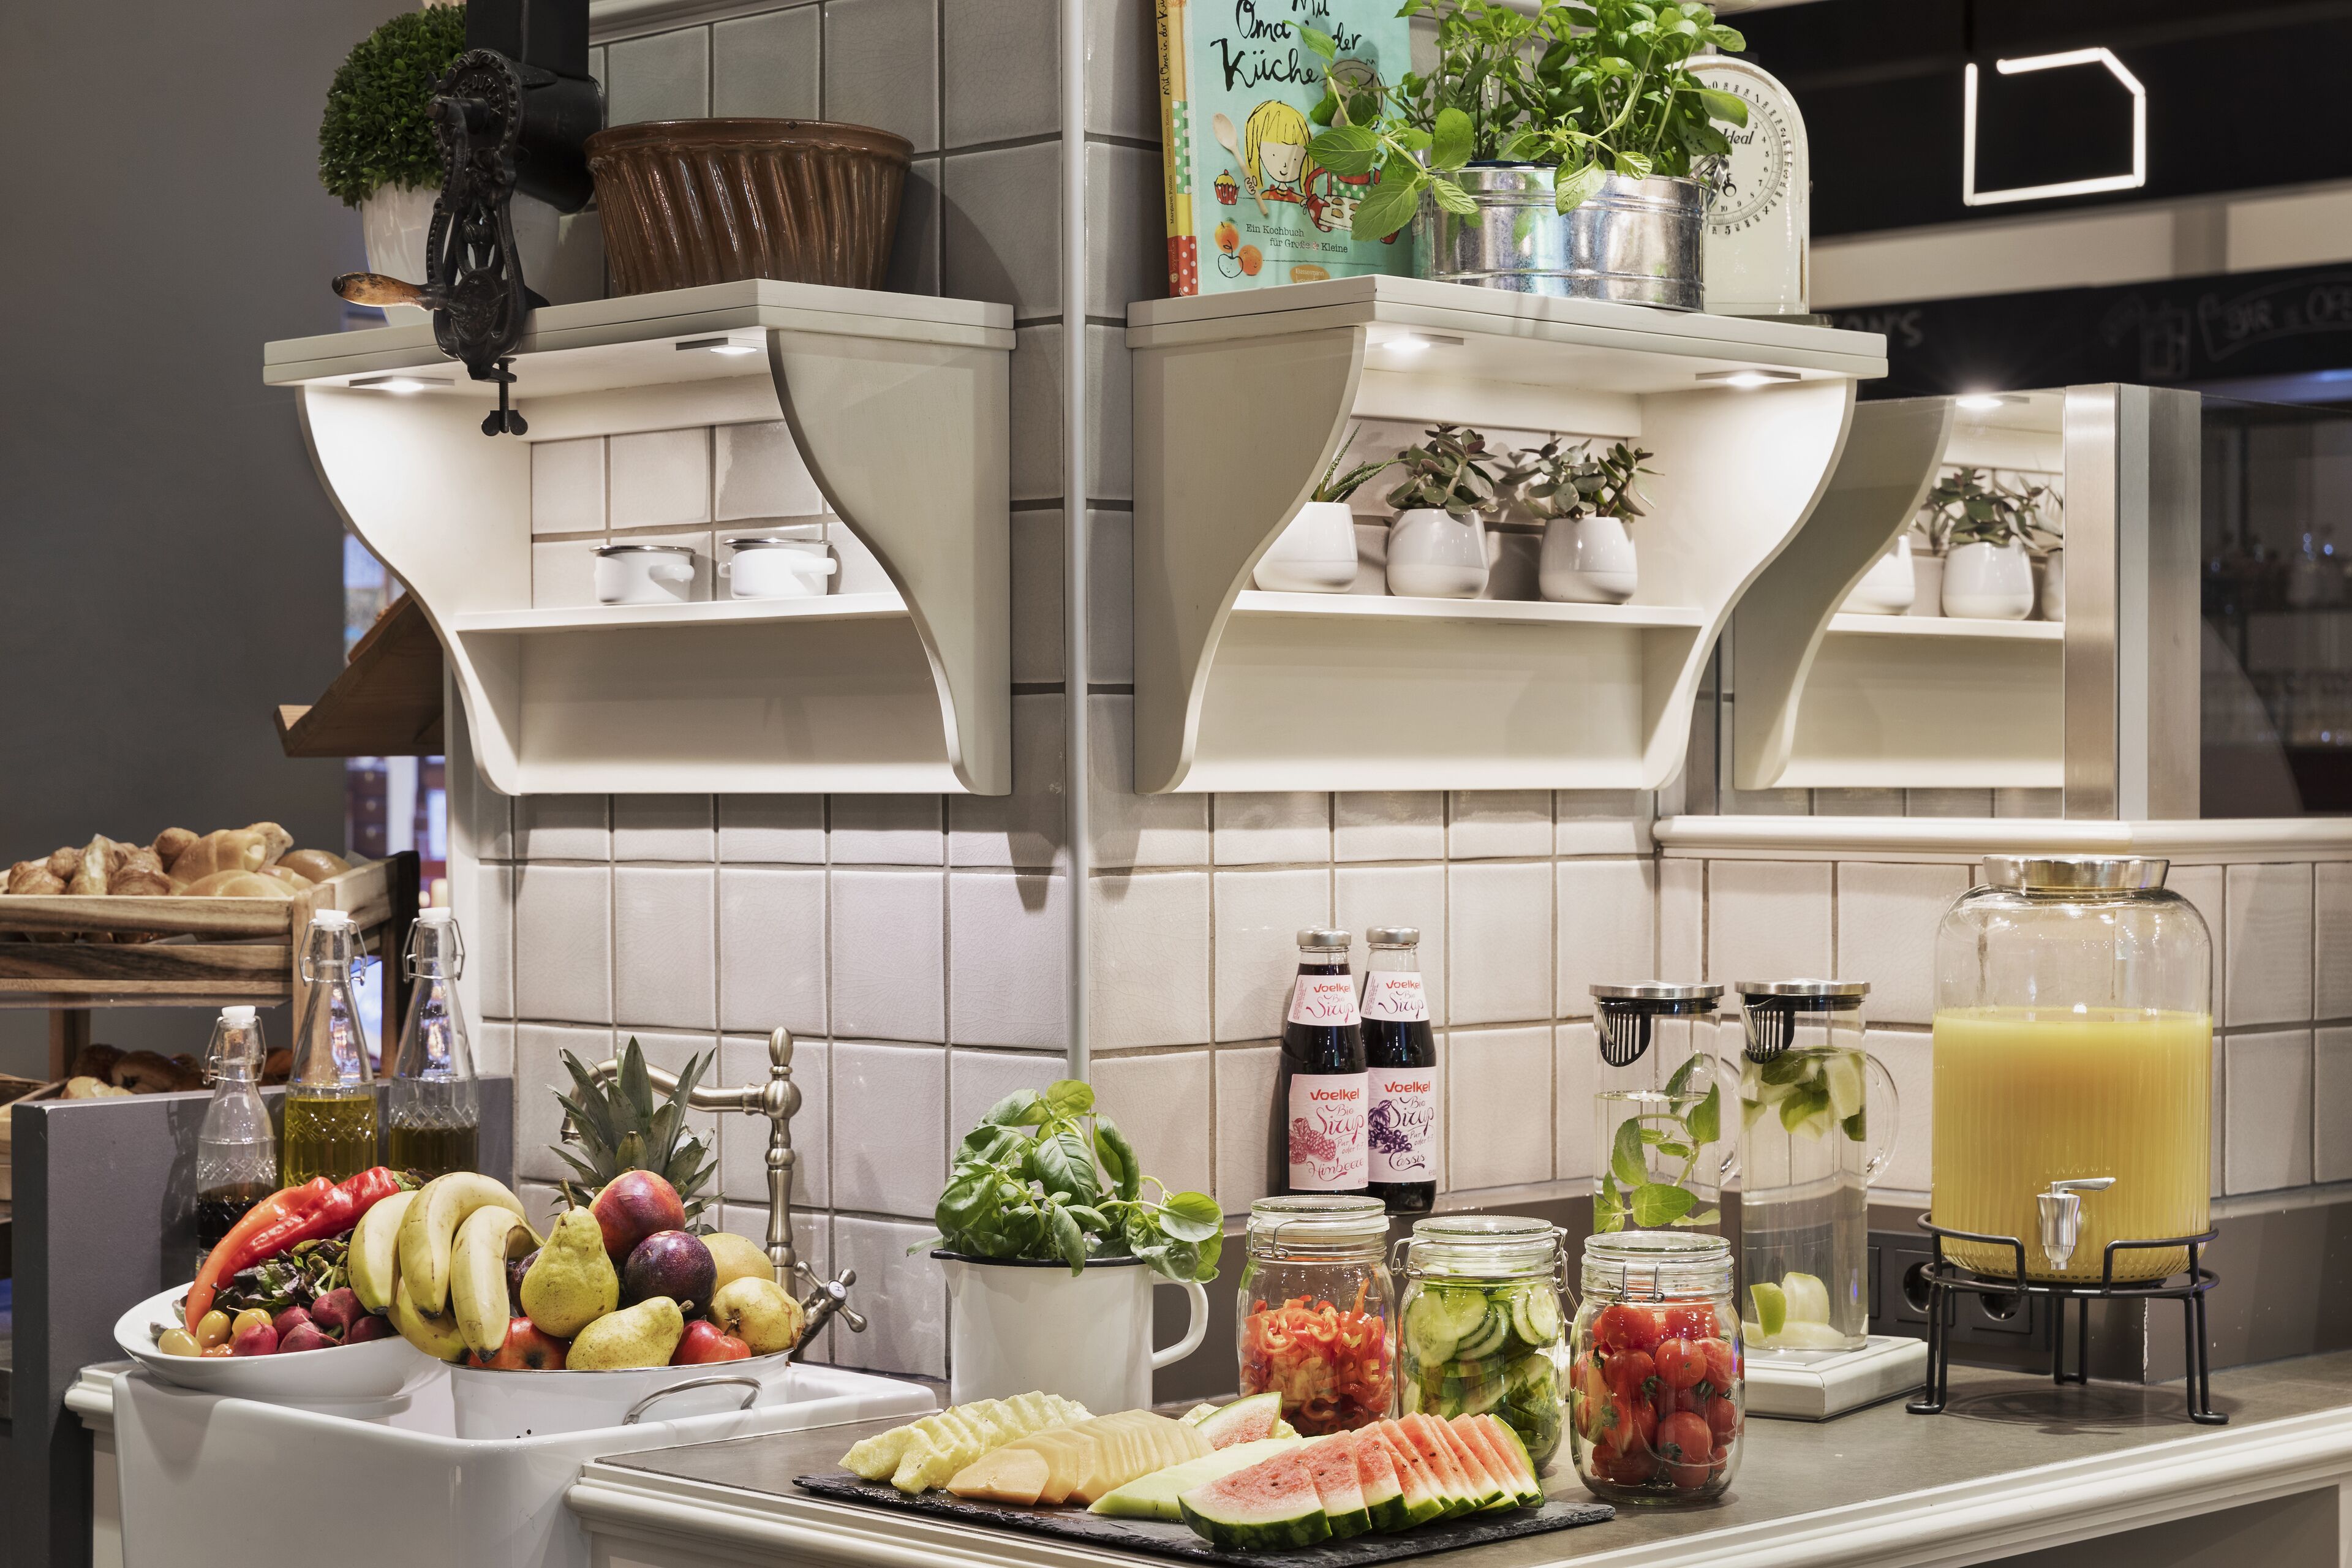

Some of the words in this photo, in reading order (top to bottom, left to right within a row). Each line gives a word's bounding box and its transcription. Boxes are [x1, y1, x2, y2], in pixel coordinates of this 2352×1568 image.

[1236, 0, 1291, 42] Oma
[1210, 38, 1319, 91] Küche
[1246, 224, 1261, 233] Ein
[1263, 225, 1305, 237] Kochbuch
[1270, 238, 1283, 247] für
[1321, 243, 1349, 253] Kleine
[1314, 983, 1351, 993] Voelkel
[1386, 980, 1421, 990] Voelkel
[1306, 996, 1354, 1023] Sirup
[1378, 992, 1423, 1019] Sirup
[1310, 1088, 1359, 1101] Voelkel
[1384, 1081, 1430, 1093] Voelkel
[1316, 1107, 1364, 1144] Sirup
[1389, 1099, 1434, 1136] Sirup
[1306, 1157, 1363, 1182] Himbeere
[1389, 1151, 1425, 1171] Cassis
